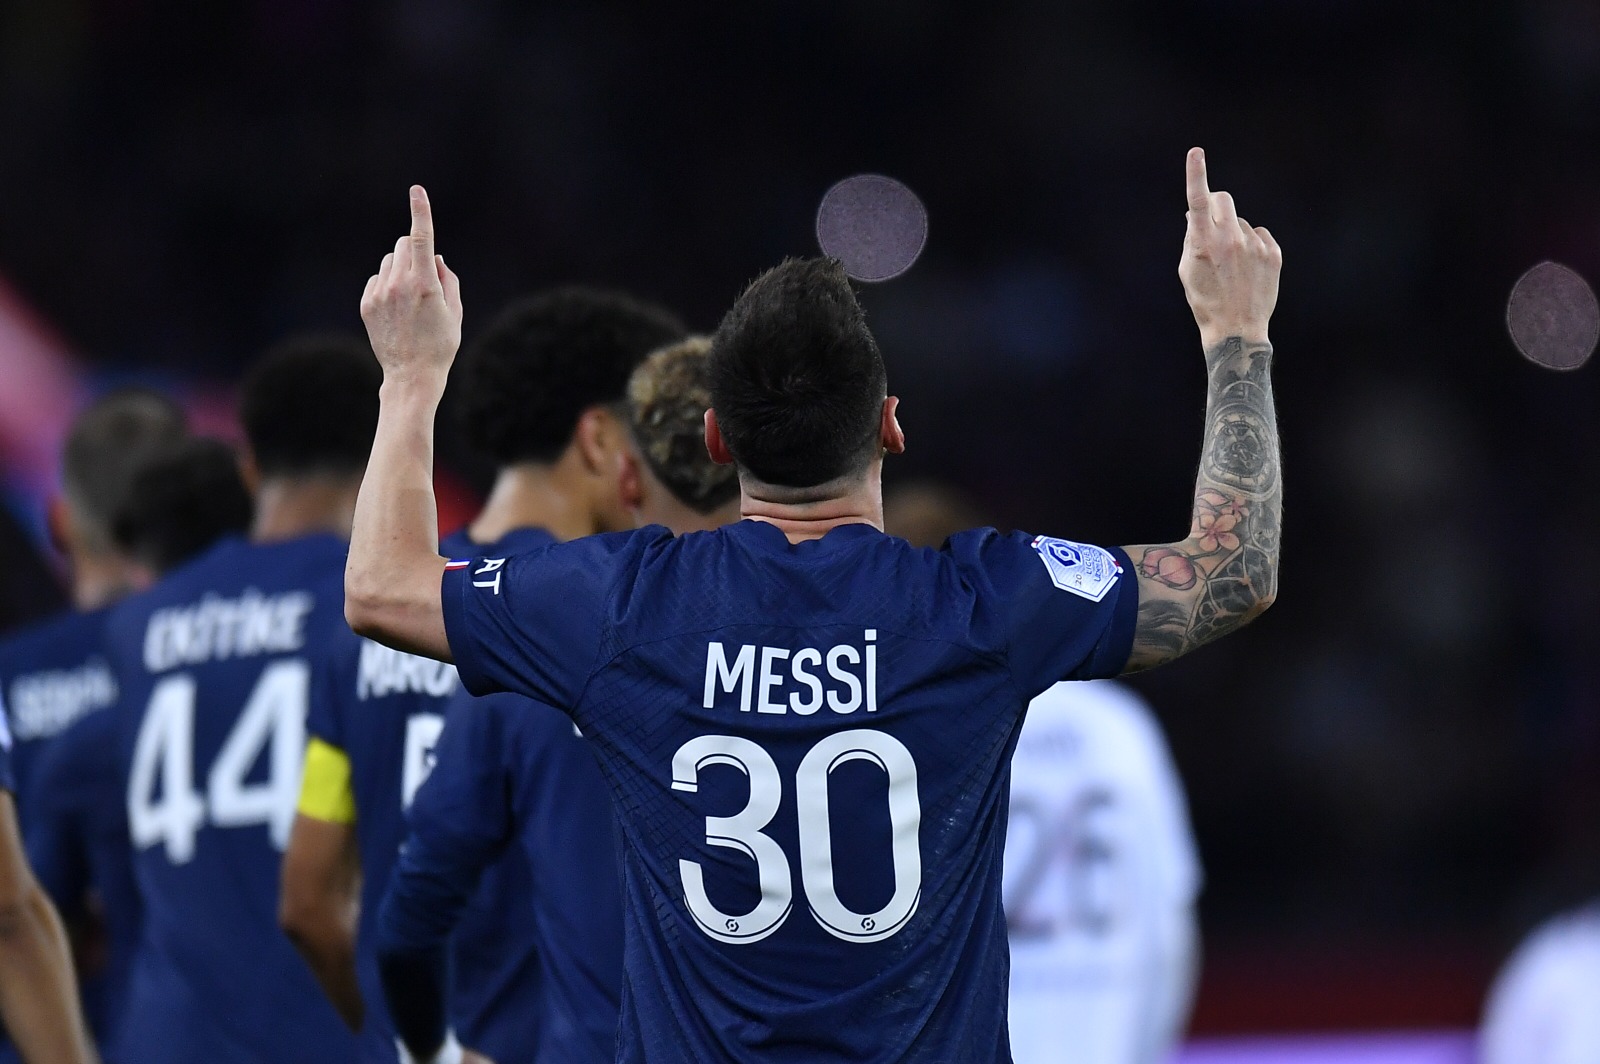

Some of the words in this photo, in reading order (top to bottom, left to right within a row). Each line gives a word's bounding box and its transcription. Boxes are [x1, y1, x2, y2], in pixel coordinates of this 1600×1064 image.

[128, 660, 309, 864] 44
[702, 628, 878, 715] MESSI
[670, 728, 922, 945] 30
